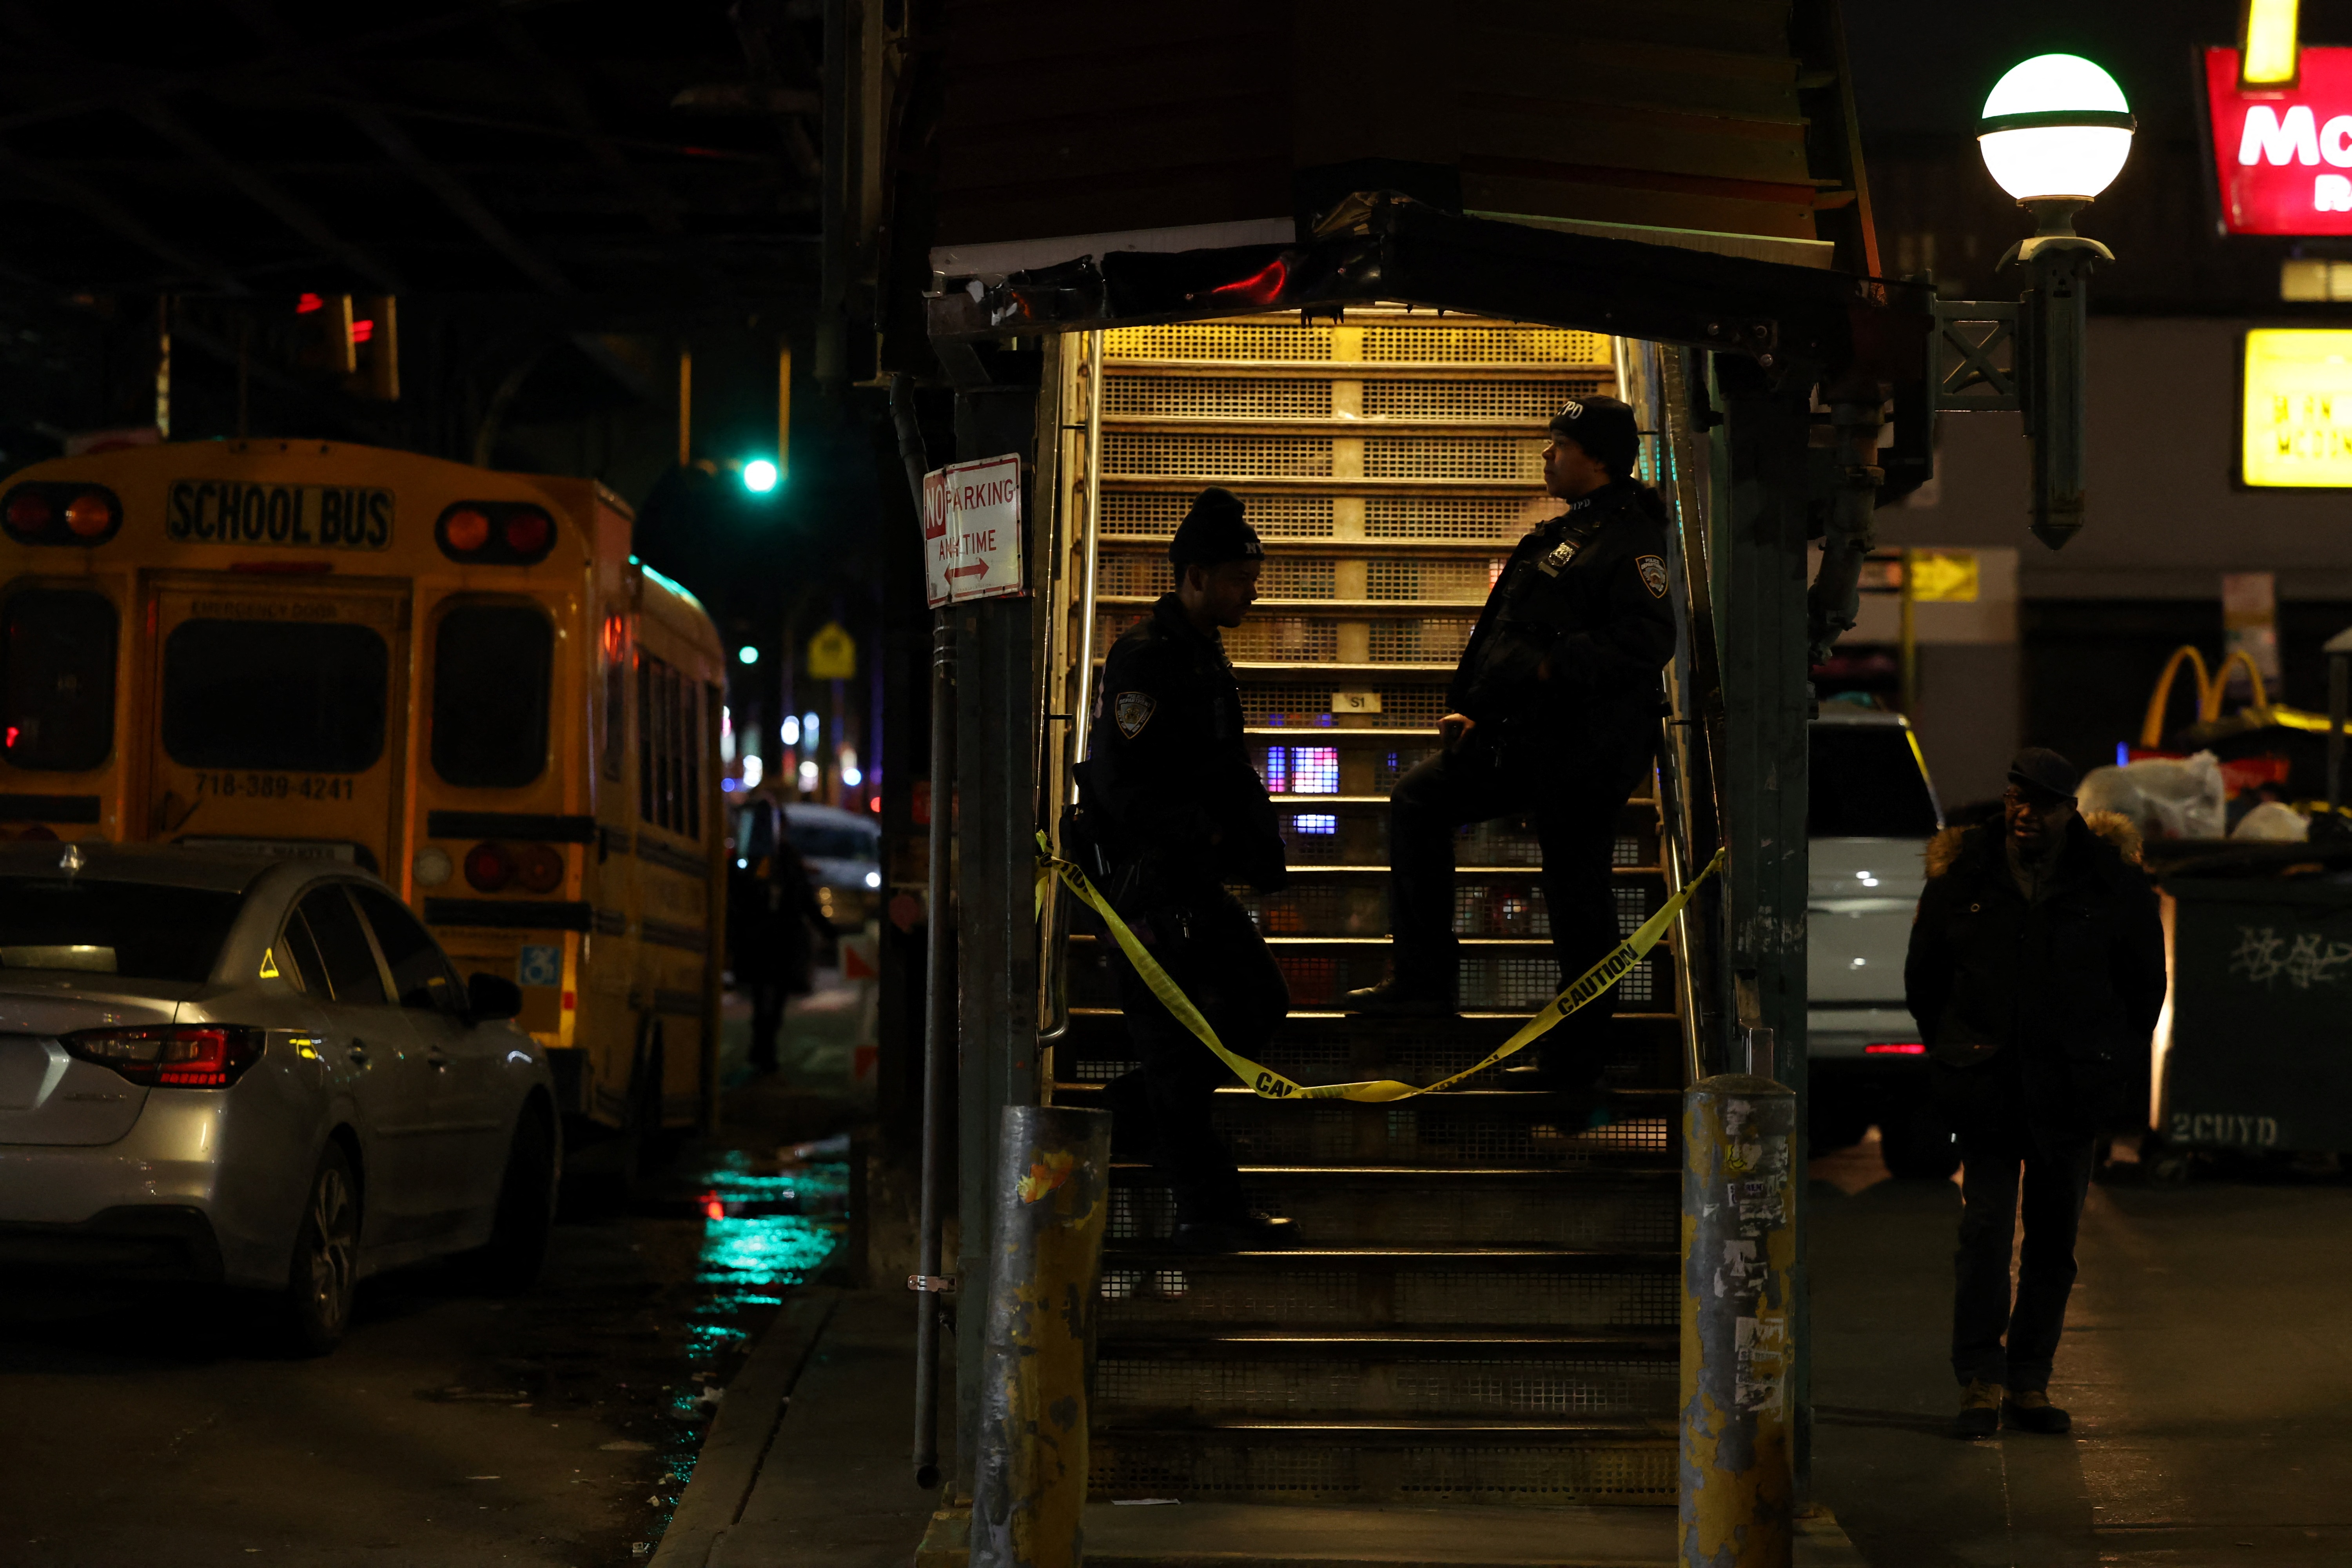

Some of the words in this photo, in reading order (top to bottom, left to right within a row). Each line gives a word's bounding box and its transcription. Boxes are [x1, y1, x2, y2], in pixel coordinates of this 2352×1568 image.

[171, 483, 311, 543] SCHOOL
[319, 489, 392, 546] BUS
[926, 484, 944, 529] NO
[946, 479, 1014, 514] PARKING
[939, 529, 996, 561] ANYTIME
[1351, 697, 1365, 707] S1
[196, 772, 352, 800] 718-389-4241
[1557, 943, 1639, 1015] CAUTION
